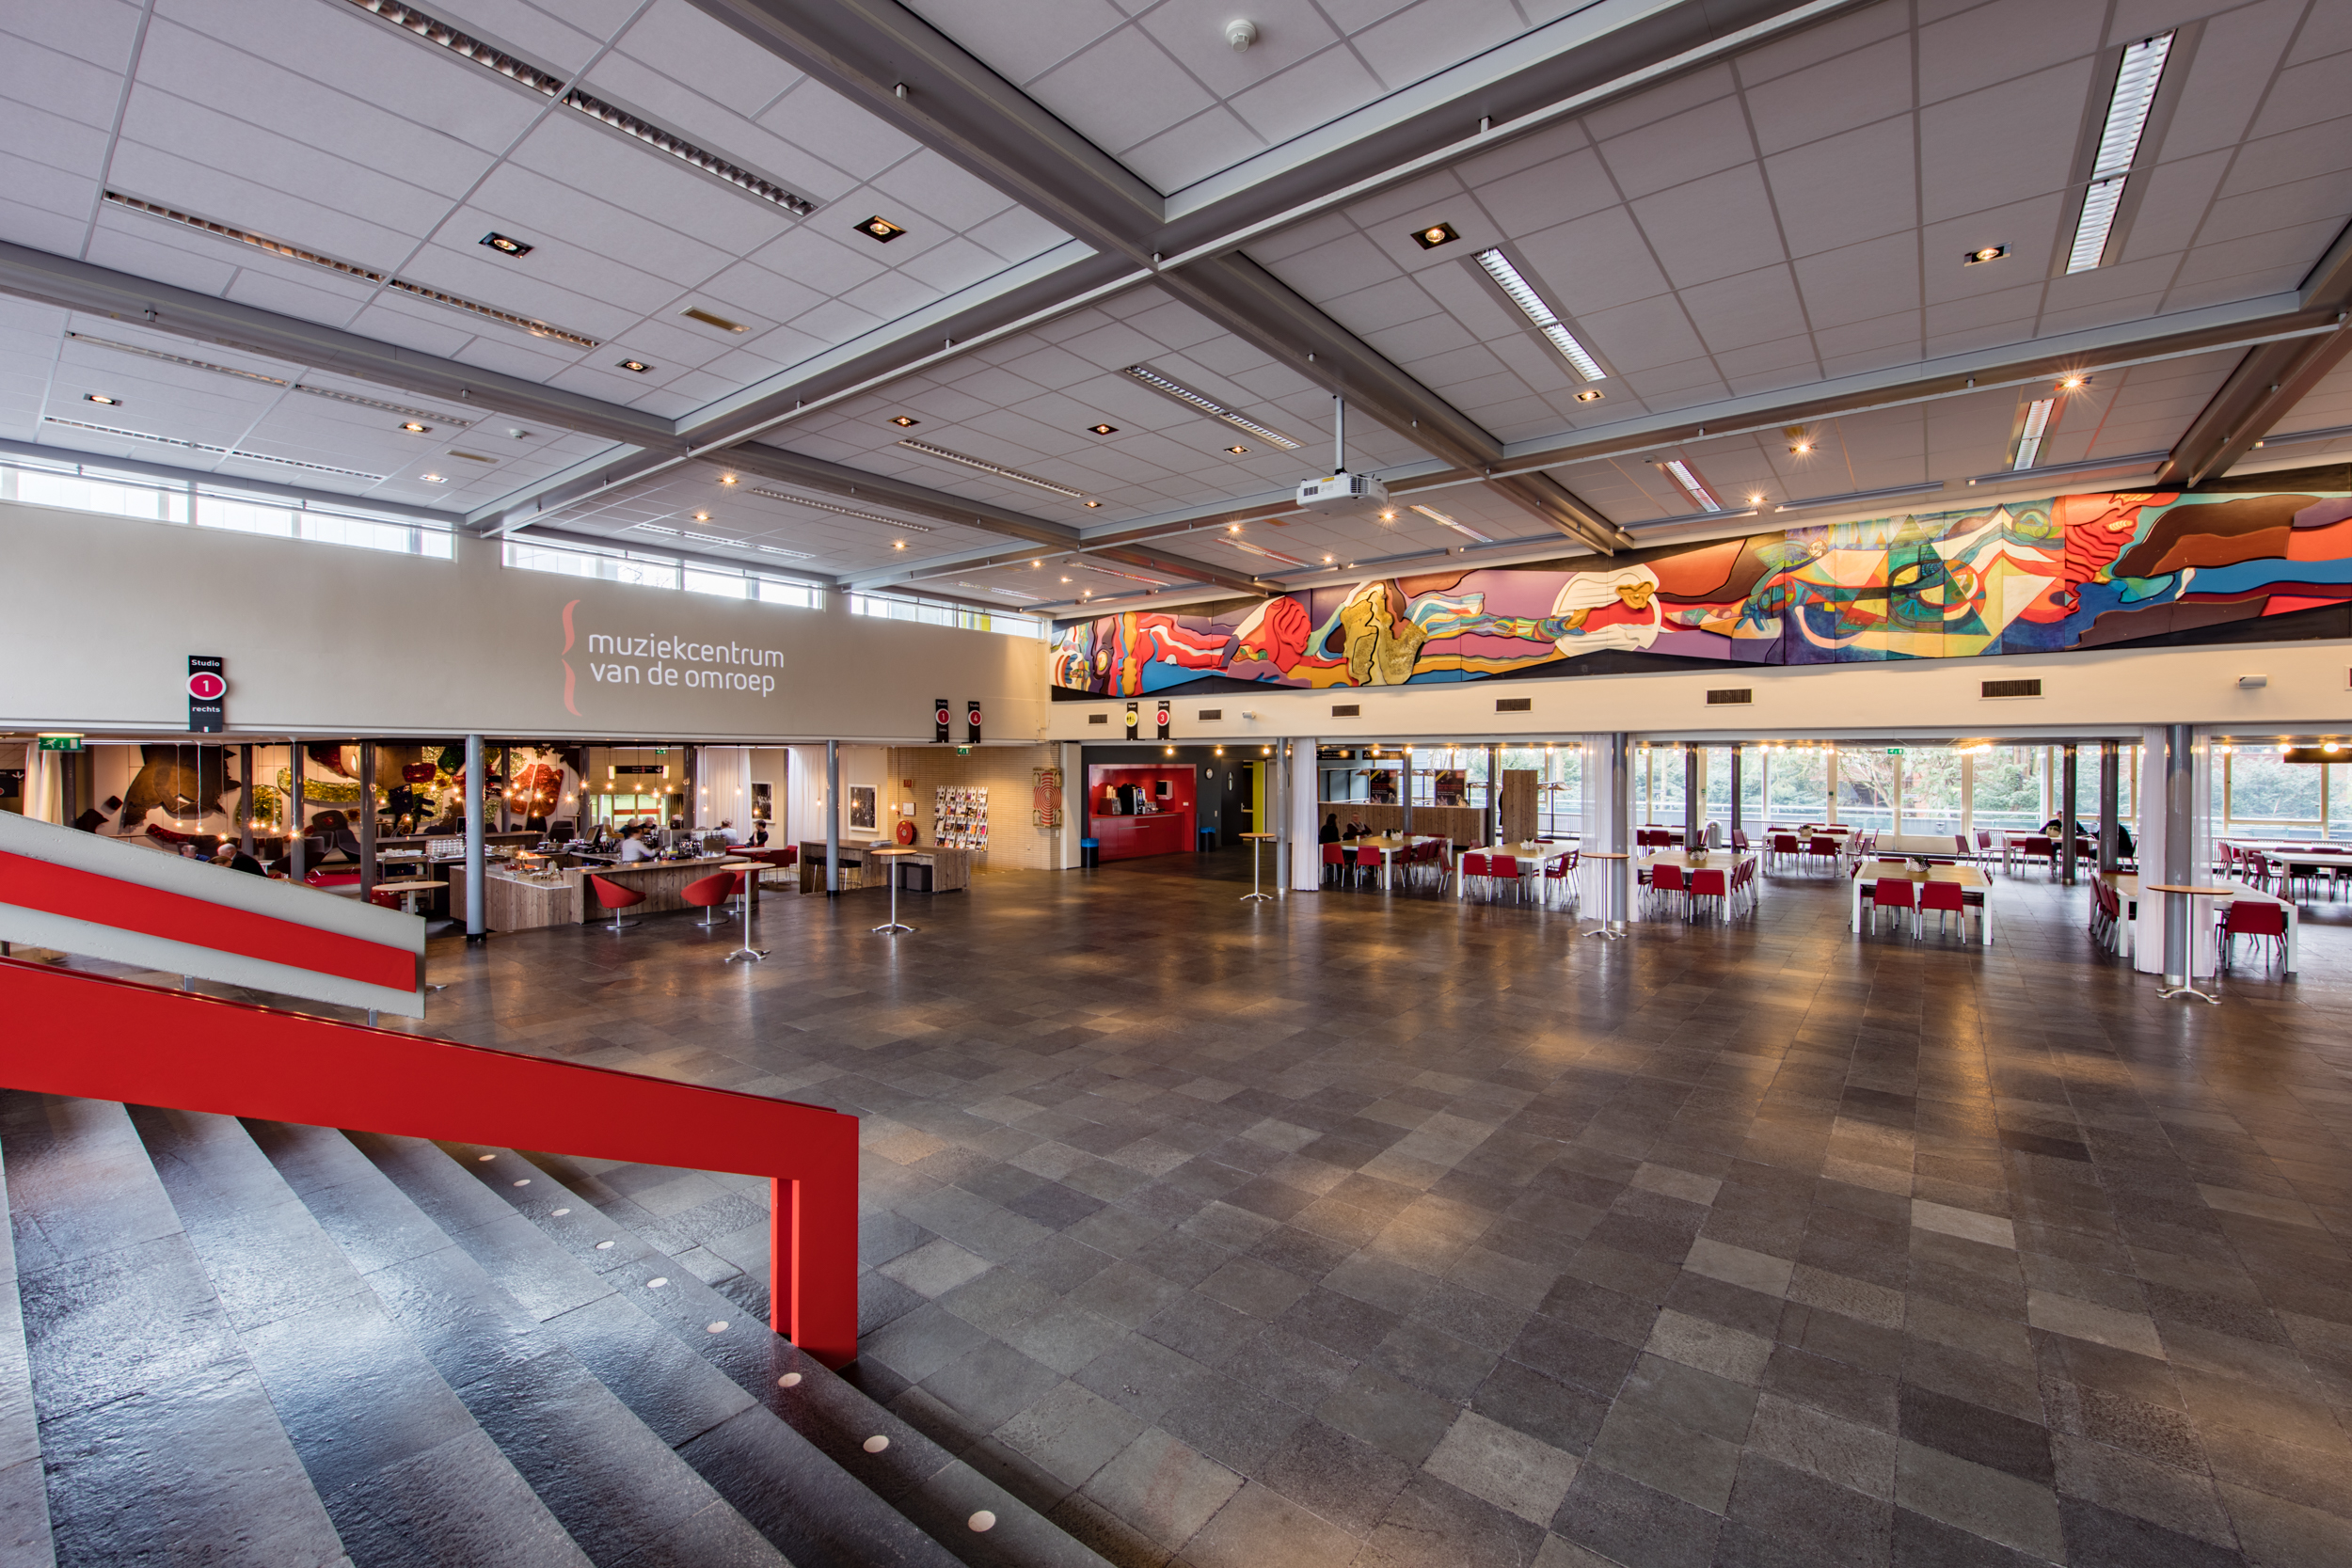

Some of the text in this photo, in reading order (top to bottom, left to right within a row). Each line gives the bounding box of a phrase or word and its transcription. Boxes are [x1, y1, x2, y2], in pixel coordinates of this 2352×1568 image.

[588, 633, 785, 668] muziekcentrum
[202, 680, 209, 692] 1
[590, 660, 775, 698] van de omroep
